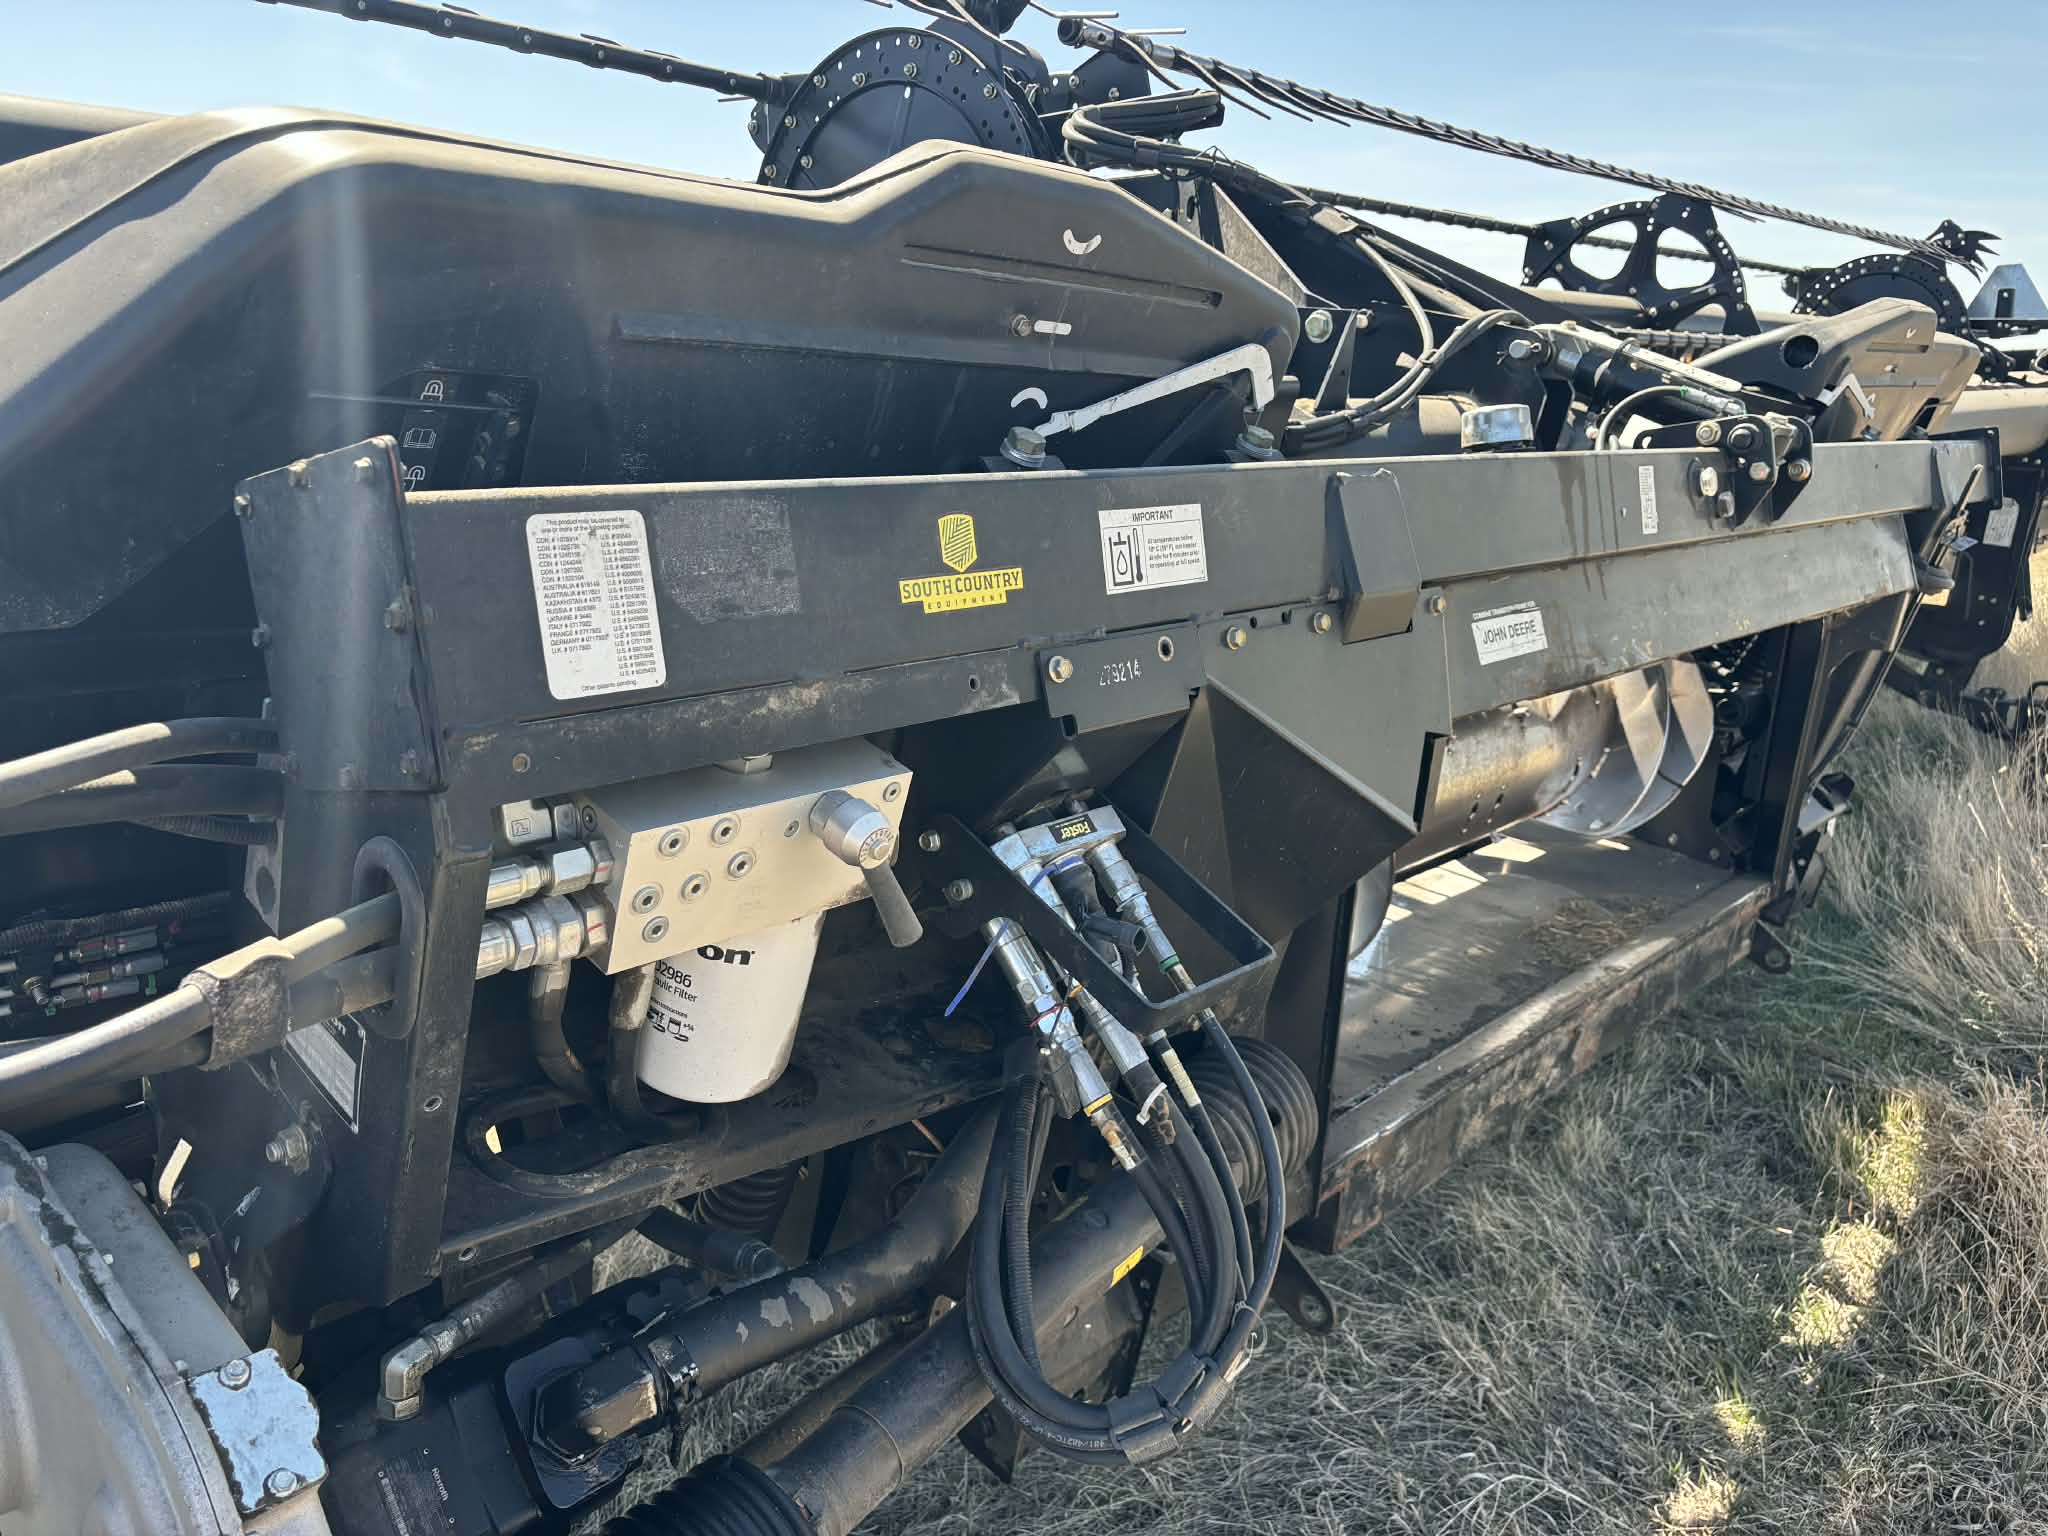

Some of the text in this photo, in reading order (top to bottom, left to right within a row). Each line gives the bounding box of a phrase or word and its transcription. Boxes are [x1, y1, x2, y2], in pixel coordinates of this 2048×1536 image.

[1132, 510, 1172, 522] IMPORTANT
[902, 571, 1020, 600] SOUTH COUNTRY
[927, 593, 1003, 610] EQUIPMENT
[1483, 619, 1537, 645] JOHN DEERE
[697, 944, 751, 965] on
[673, 986, 698, 1003] Filter
[432, 1467, 449, 1502] Rexroth
